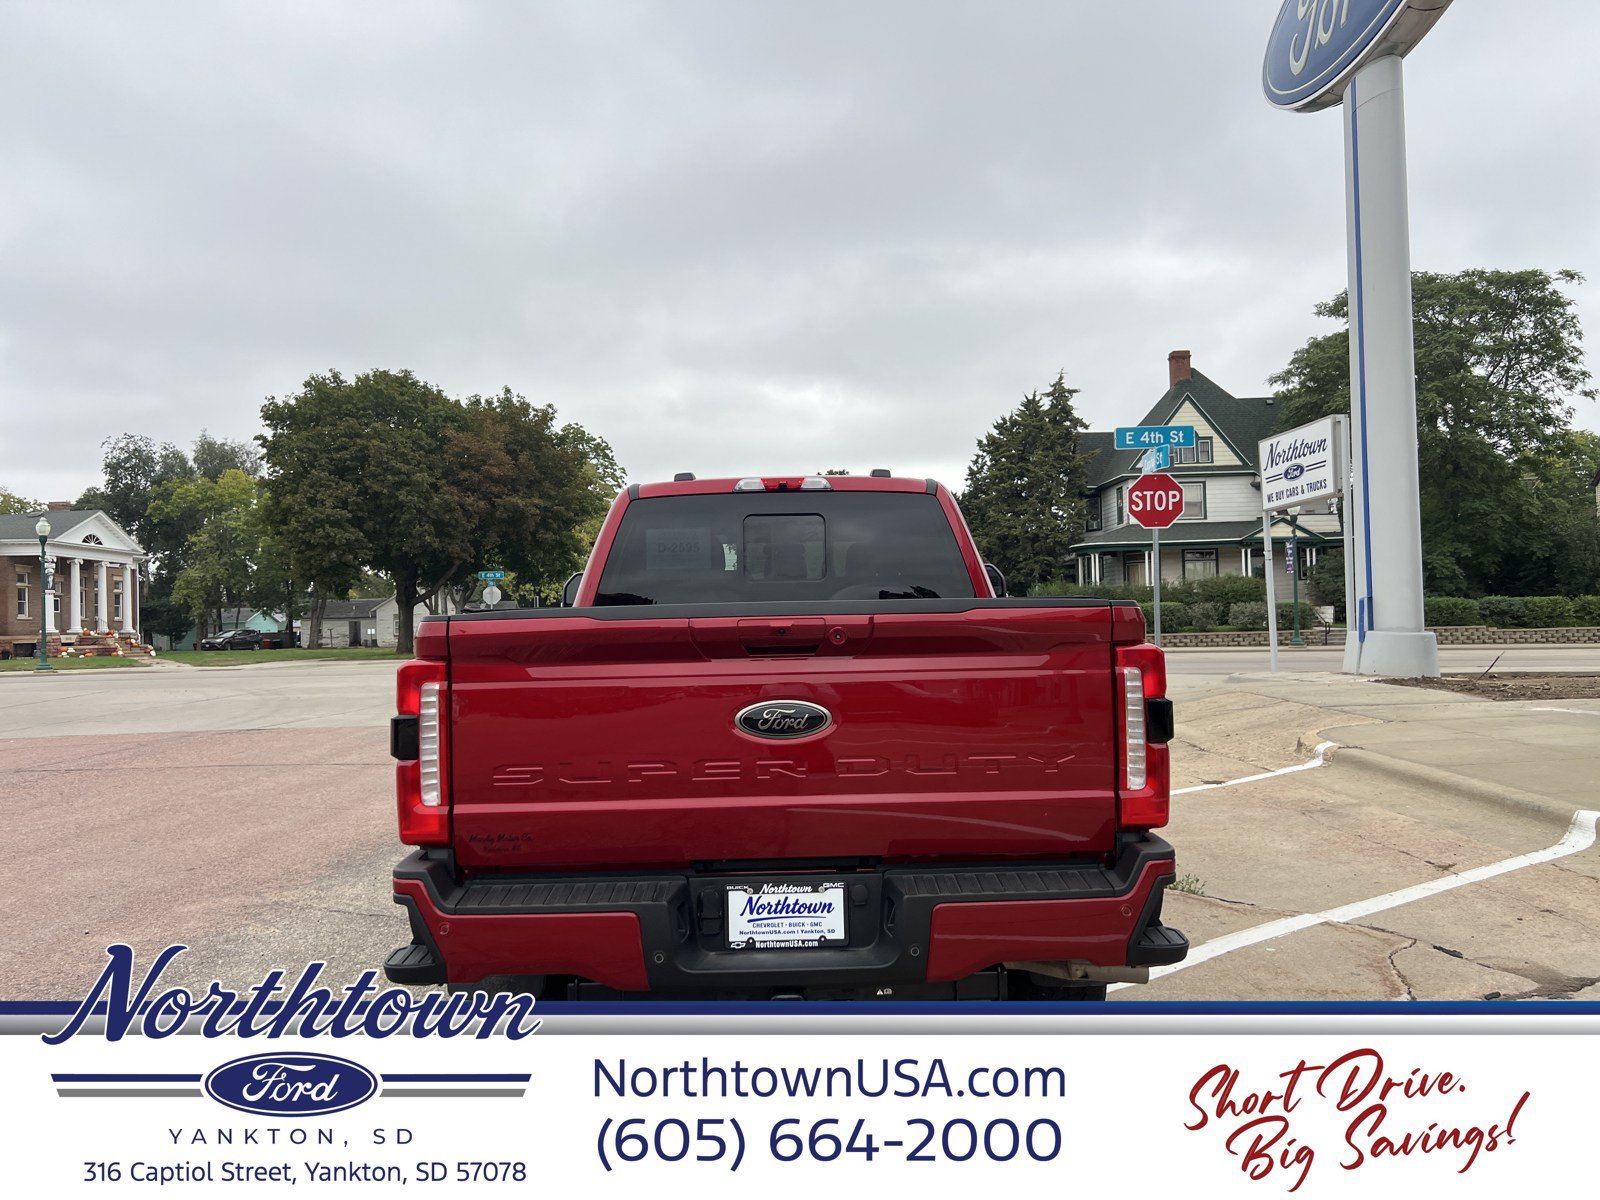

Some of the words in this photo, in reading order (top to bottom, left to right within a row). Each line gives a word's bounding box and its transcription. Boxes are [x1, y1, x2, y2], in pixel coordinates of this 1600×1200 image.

[1126, 431, 1135, 445] E
[1140, 431, 1164, 444] 4th
[1169, 430, 1185, 443] St
[1263, 438, 1328, 472] Northtown
[1287, 465, 1301, 479] Ford
[1131, 490, 1181, 512] STOP
[1267, 492, 1274, 503] WE
[1275, 489, 1285, 501] BUY
[1286, 486, 1299, 499] CARS
[1300, 484, 1305, 495] &
[1306, 478, 1327, 493] TRUCKS
[757, 708, 809, 730] Ford
[492, 757, 807, 787] SUPER
[836, 753, 1076, 777] DUTY
[759, 883, 813, 894] Northtown
[739, 895, 835, 917] Northtown
[755, 940, 819, 949] NorthtownUSA.com
